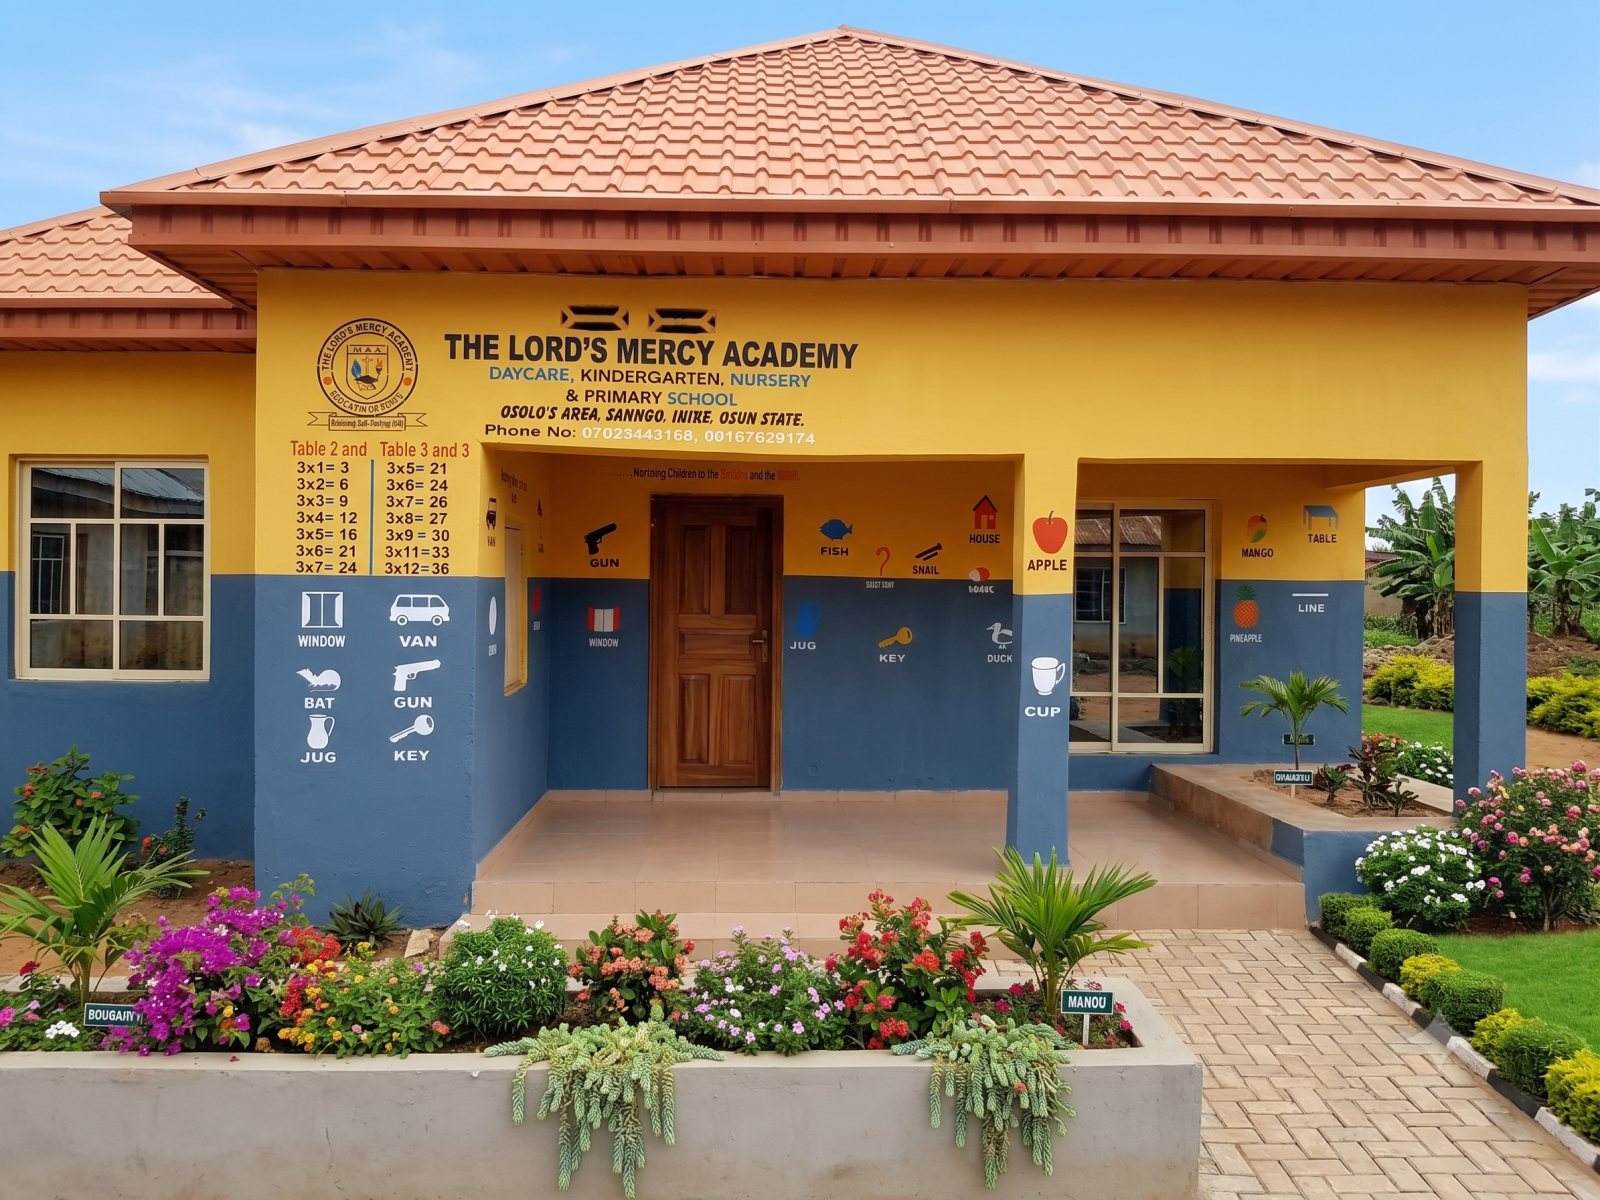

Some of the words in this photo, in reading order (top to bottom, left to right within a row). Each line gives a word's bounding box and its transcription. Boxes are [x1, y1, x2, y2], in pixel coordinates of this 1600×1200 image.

[321, 352, 332, 371] THE
[355, 322, 388, 334] MERCY
[387, 331, 414, 372] ACADEMY
[444, 333, 500, 361] THE
[509, 335, 608, 363] LORD'S
[617, 338, 715, 366] MERCY
[722, 340, 859, 369] ACADEMY
[489, 366, 574, 383] DAYCARE,
[730, 373, 811, 388] NURSERY
[566, 389, 579, 402] &
[584, 389, 662, 405] PRIMARY
[667, 391, 738, 406] SCHOOL
[501, 405, 558, 419] OSOLO'S
[561, 407, 601, 423] AREA,
[719, 411, 757, 425] OSUN
[760, 412, 805, 427] STATE.
[485, 424, 541, 437] Phone
[547, 426, 576, 438] No:
[582, 427, 698, 443] 07023443168,
[704, 430, 816, 445] 00167629174
[290, 440, 326, 456] Table
[330, 441, 338, 456] 2
[342, 441, 367, 456] and
[380, 441, 416, 457] Table
[420, 442, 428, 457] 3
[432, 443, 458, 458] and
[461, 443, 470, 457] 3
[340, 461, 349, 474] 3
[429, 462, 447, 475] 21
[667, 468, 697, 478] Children
[698, 469, 706, 478] to
[707, 469, 719, 479] the
[749, 470, 763, 480] and
[764, 470, 776, 480] the
[339, 478, 349, 491] 6
[429, 479, 449, 492] 24
[339, 494, 348, 507] 9
[429, 496, 448, 509] 26
[339, 512, 358, 525] 12
[429, 512, 448, 525] 27
[339, 528, 358, 541] 16
[431, 530, 450, 543] 30
[969, 534, 1000, 544] HOUSE
[1308, 534, 1337, 543] TABLE
[338, 544, 356, 557] 21
[820, 547, 849, 556] FISH
[1241, 548, 1274, 558] MANGO
[338, 562, 358, 575] 24
[590, 558, 620, 568] GUN
[1027, 559, 1068, 571] APPLE
[912, 565, 939, 575] SNAIL
[1298, 604, 1325, 613] LINE
[298, 635, 346, 648] WINDOW
[399, 636, 437, 648] VAN
[588, 638, 619, 647] WINDOW
[1229, 634, 1263, 643] PINEAPPLE
[789, 641, 817, 650] JUG
[879, 654, 906, 663] KEY
[987, 654, 1013, 663] DUCK
[304, 697, 335, 709] BAT
[393, 697, 433, 708] GUN
[1024, 706, 1061, 718] CUP
[300, 752, 337, 763] JUG
[394, 750, 430, 761] KEY
[1068, 996, 1107, 1009] MANOU
